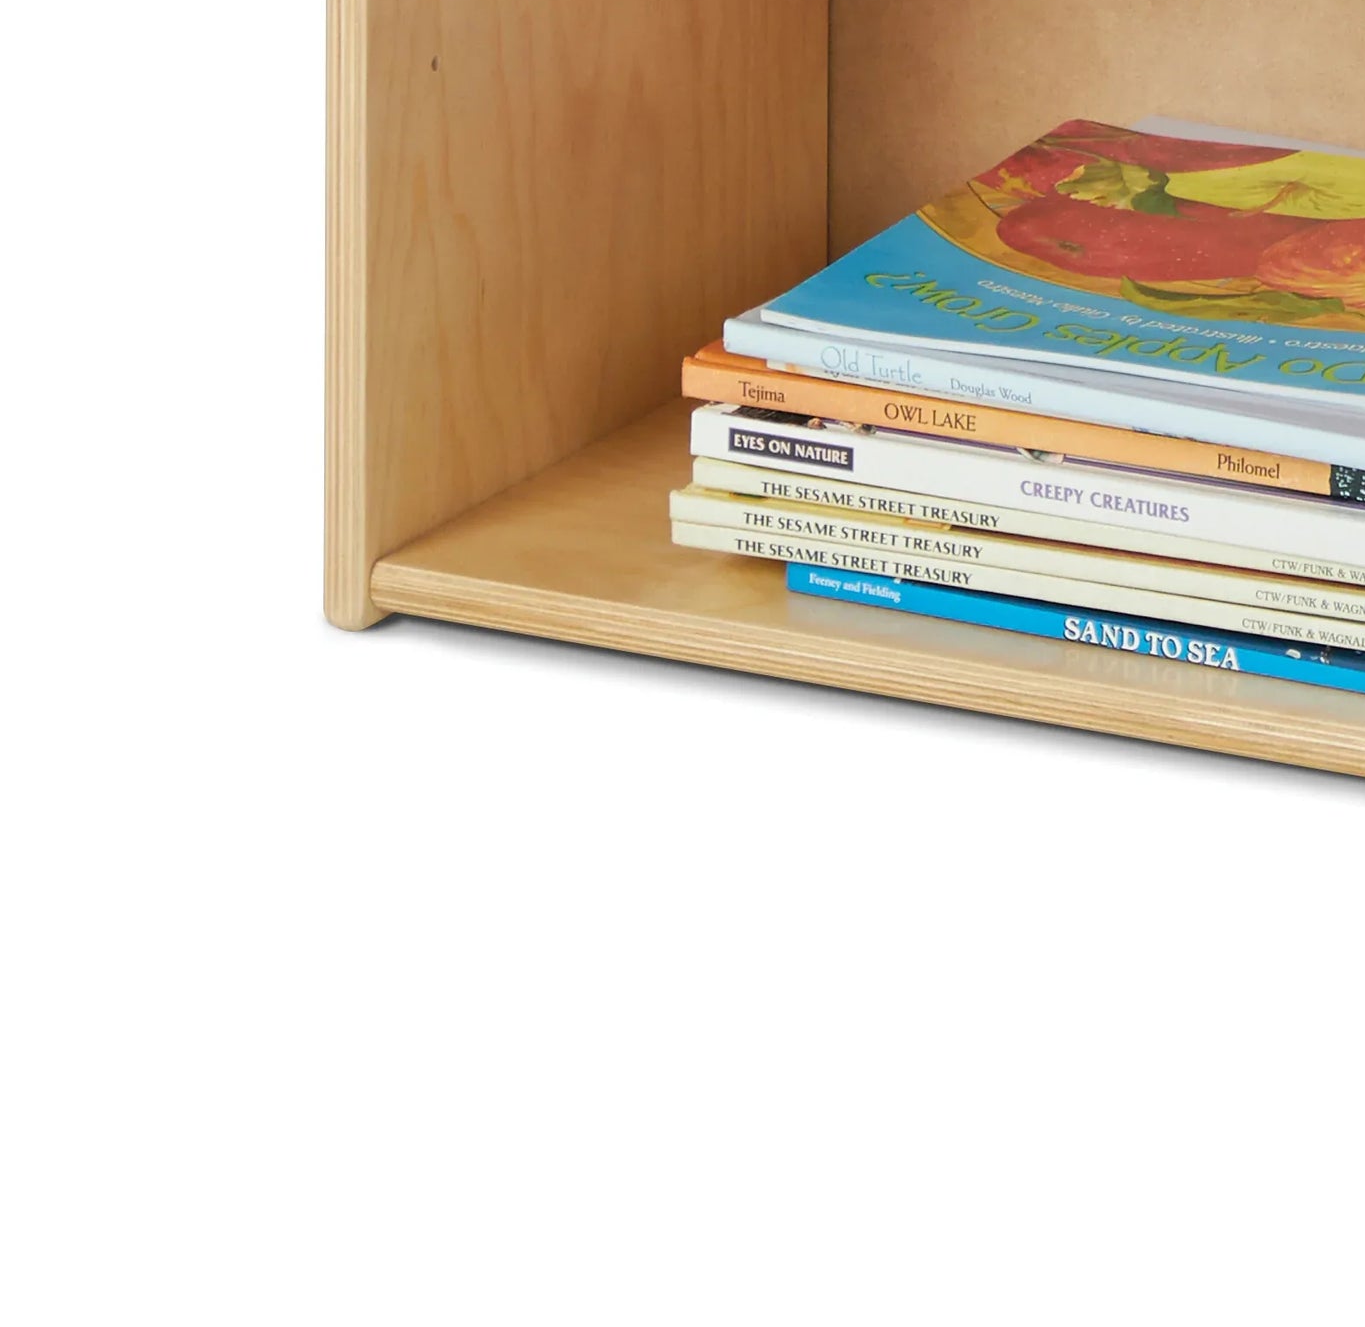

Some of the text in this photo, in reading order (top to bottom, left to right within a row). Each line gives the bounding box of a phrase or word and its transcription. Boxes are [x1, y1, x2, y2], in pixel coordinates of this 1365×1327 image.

[863, 270, 1041, 334] Grow?
[1044, 322, 1268, 375] Apples
[820, 345, 923, 386] Old Turtle
[738, 380, 786, 405] Tejima
[950, 376, 1032, 406] Douglas Wood
[883, 402, 978, 433] OWL LAKE
[733, 433, 850, 466] EYES ON NATURE
[1217, 452, 1282, 481] Philomel
[761, 480, 1000, 529] THE SESAME STREET TREASURY
[1020, 479, 1191, 523] CREEPY CREATURES
[743, 511, 984, 560] THE SESAME STREET TREASURY
[735, 538, 973, 586] THE SESAME STREET TREASURY
[1272, 558, 1334, 579] CTW/FUNK
[808, 572, 902, 605] Feeney and Fielding
[1255, 589, 1317, 609] CTW/FUNK
[1242, 617, 1303, 638] CTW/FUNK
[1063, 616, 1241, 673] SAND TO SEA
